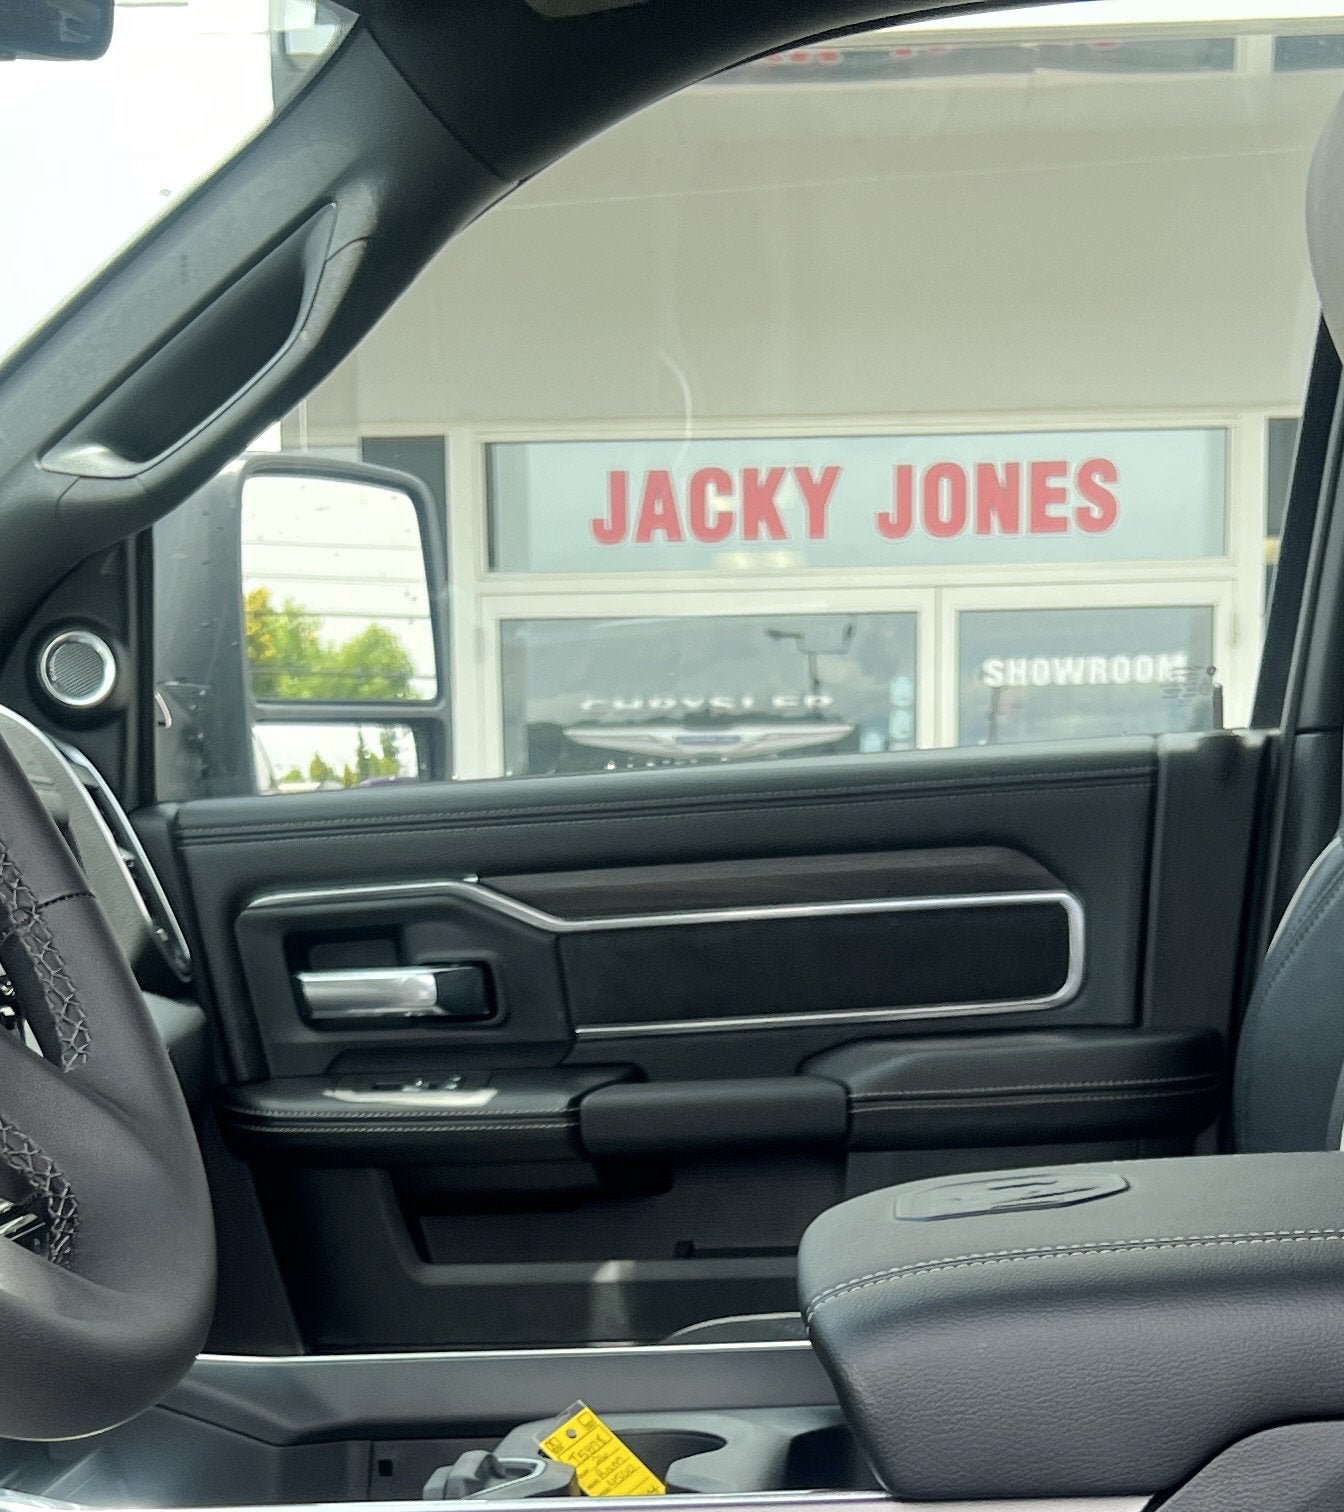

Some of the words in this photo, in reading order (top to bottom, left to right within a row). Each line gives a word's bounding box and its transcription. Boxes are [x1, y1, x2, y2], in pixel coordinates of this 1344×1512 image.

[591, 465, 842, 545] JACKY
[877, 457, 1120, 541] JONES
[981, 650, 1189, 688] SHOWROOM
